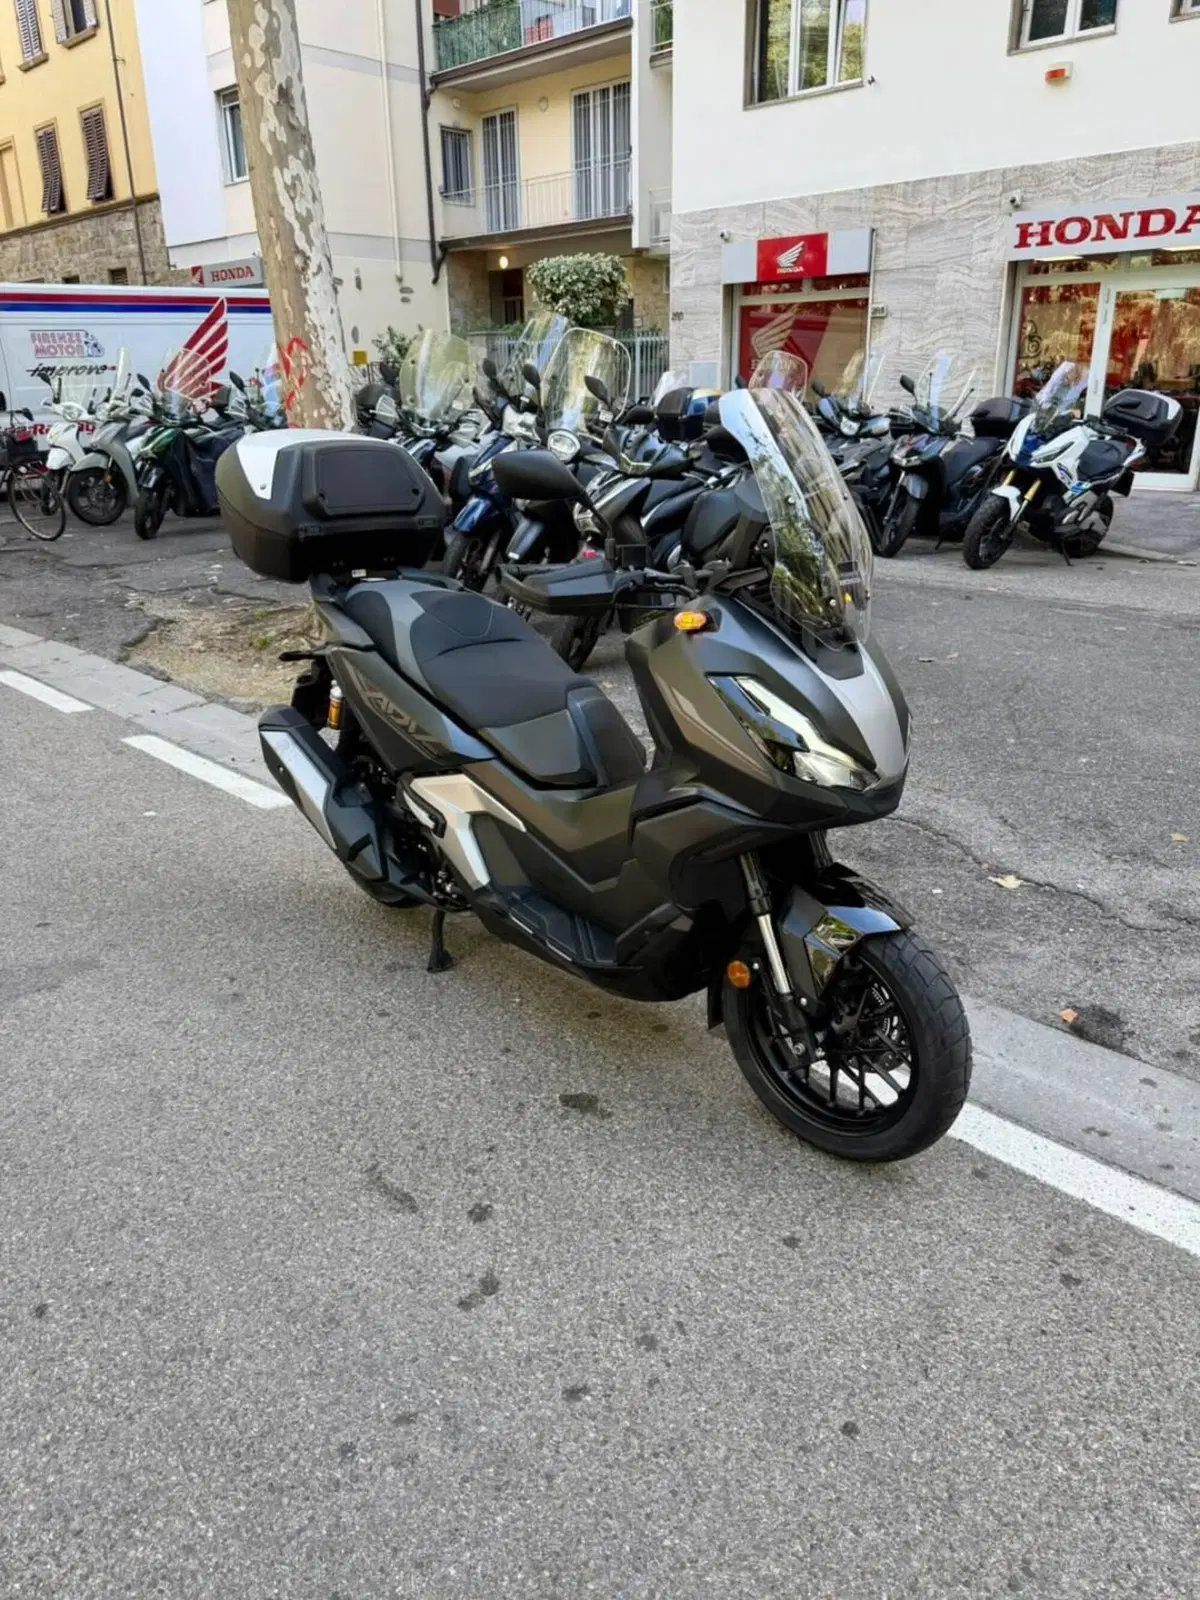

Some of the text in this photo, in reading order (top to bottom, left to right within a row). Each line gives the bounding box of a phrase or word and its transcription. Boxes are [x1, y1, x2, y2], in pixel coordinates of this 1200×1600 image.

[210, 266, 255, 283] HONDA
[30, 332, 82, 344] FIRENZE
[34, 344, 85, 356] MOTOR
[363, 690, 444, 743] ADV
